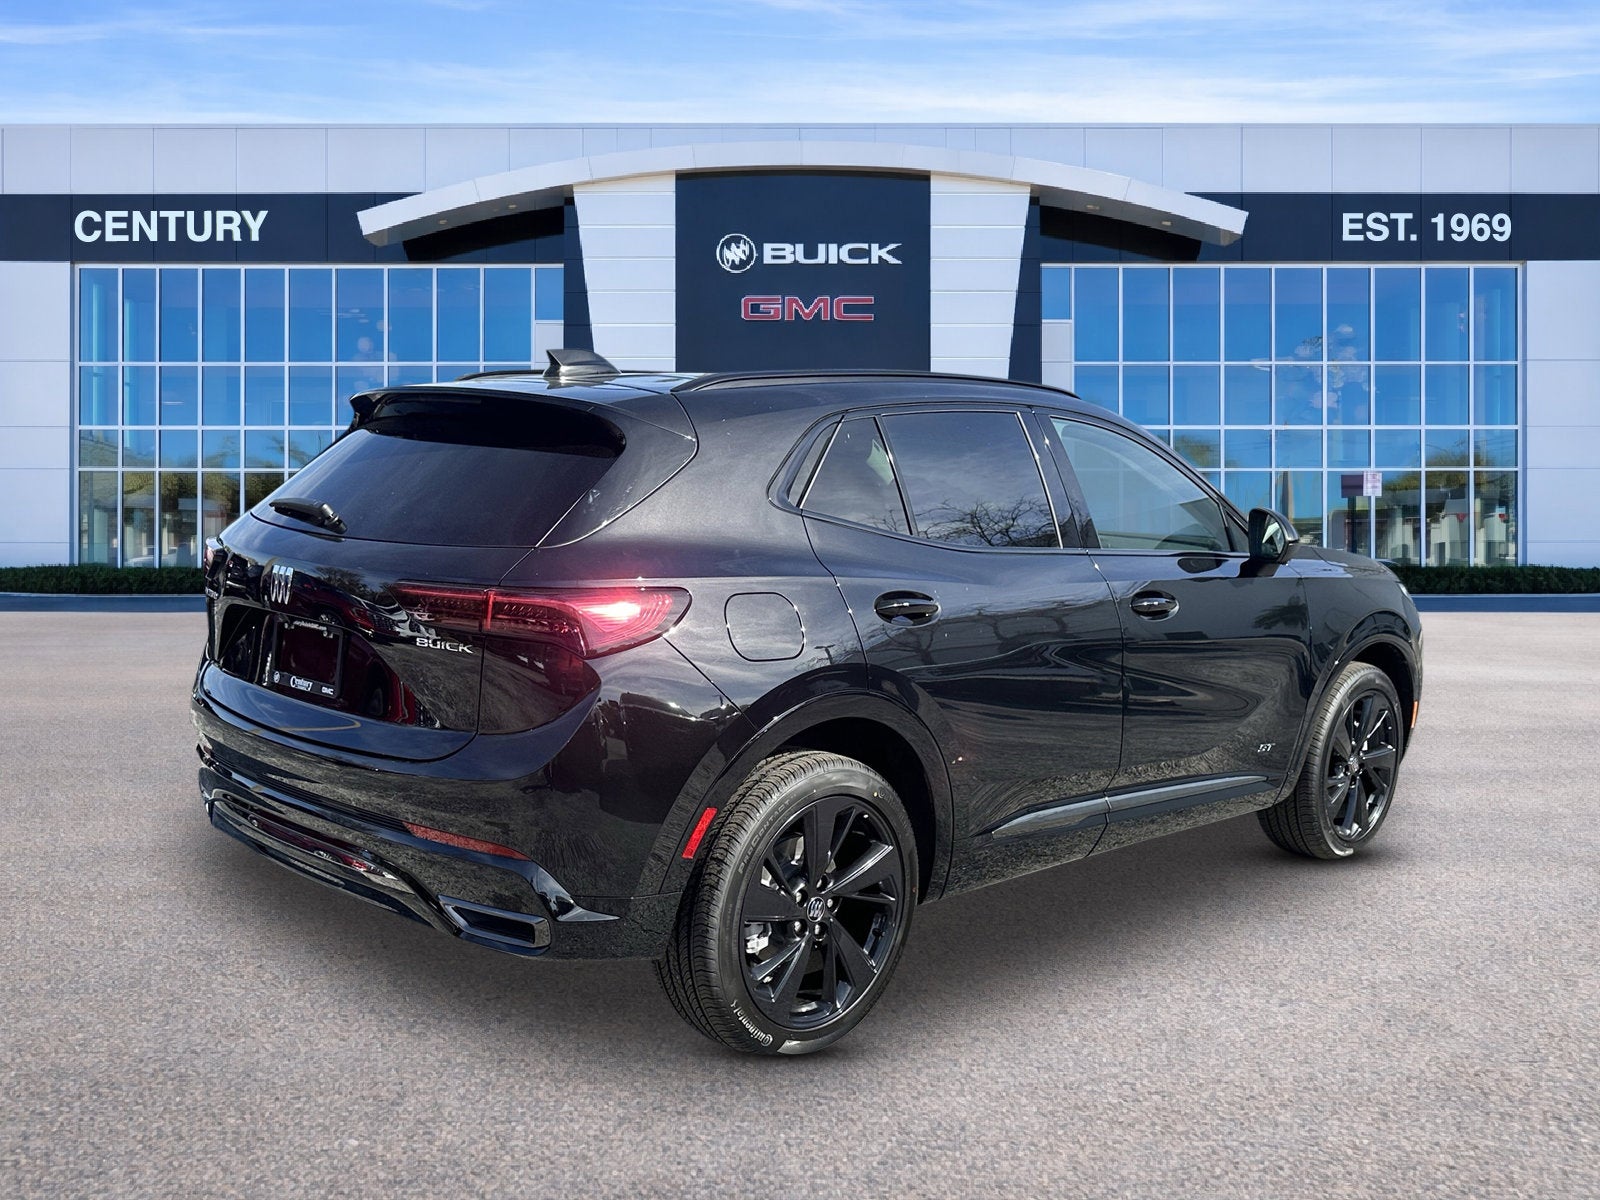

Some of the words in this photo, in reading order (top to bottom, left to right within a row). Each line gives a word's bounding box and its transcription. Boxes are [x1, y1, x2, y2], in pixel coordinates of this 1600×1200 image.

[74, 210, 269, 243] CENTURY
[1342, 212, 1418, 242] EST.
[1430, 212, 1512, 242] 1969
[763, 243, 902, 265] BUICK
[741, 295, 875, 321] GMC
[416, 637, 474, 654] BUICK
[290, 675, 313, 692] Century
